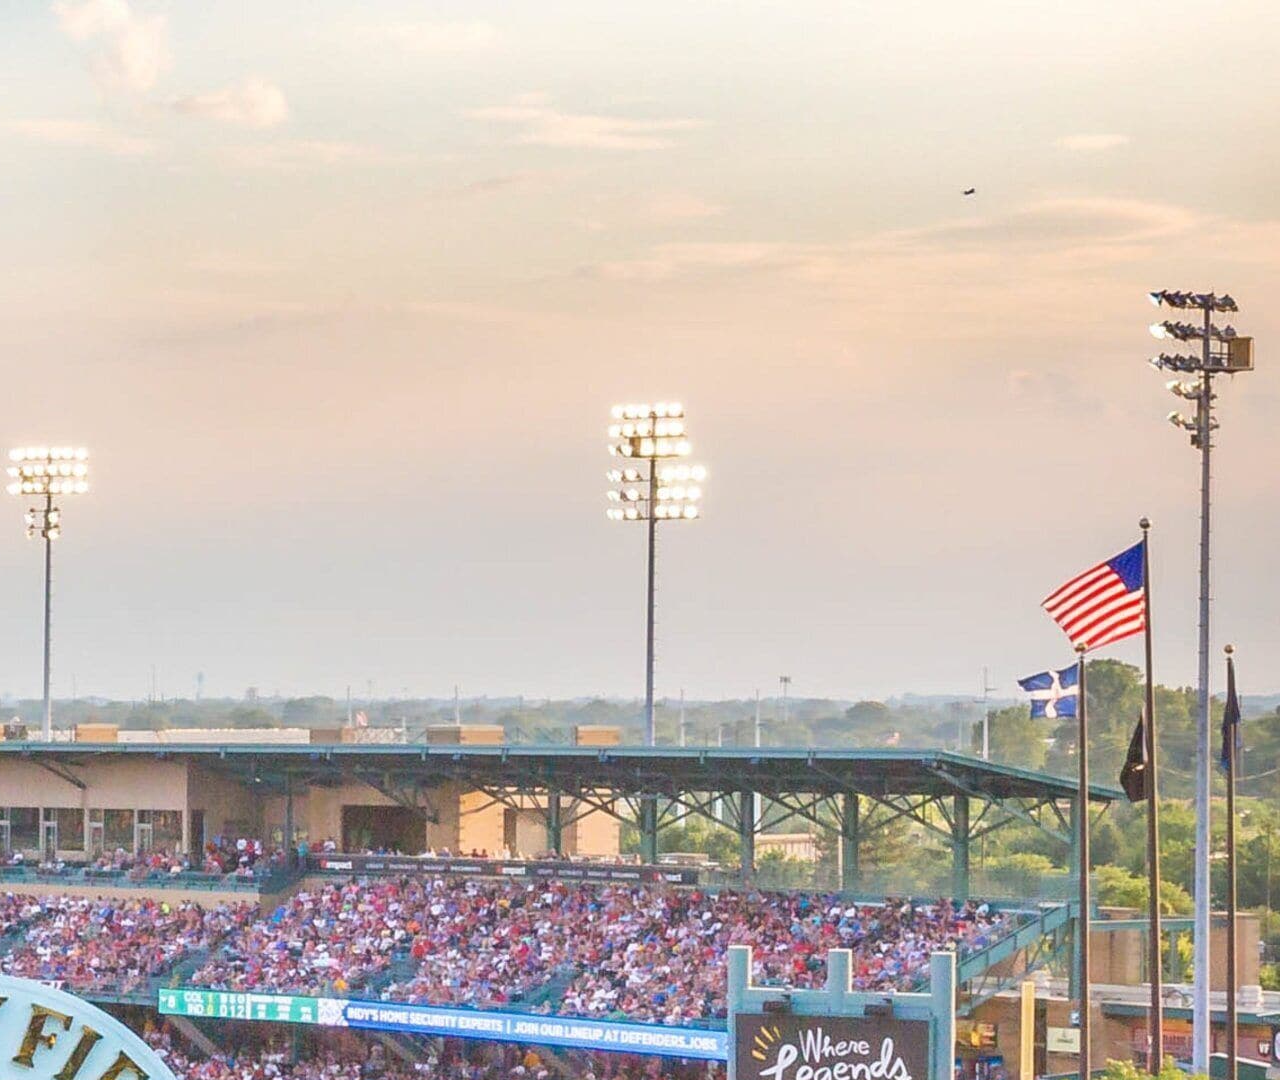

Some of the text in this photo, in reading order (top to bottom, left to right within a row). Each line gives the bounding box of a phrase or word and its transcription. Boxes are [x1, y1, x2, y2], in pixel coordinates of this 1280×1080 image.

[380, 1009, 408, 1024] HOME
[410, 1011, 458, 1029] SECURITY
[459, 1016, 503, 1032] EXPERTS
[514, 1020, 538, 1036] JOIN
[540, 1022, 563, 1037] OUR
[564, 1025, 603, 1041] LINEUP
[604, 1029, 619, 1042] AT
[621, 1031, 717, 1050] DEFENDERS.JOBS
[799, 1026, 871, 1063] Where
